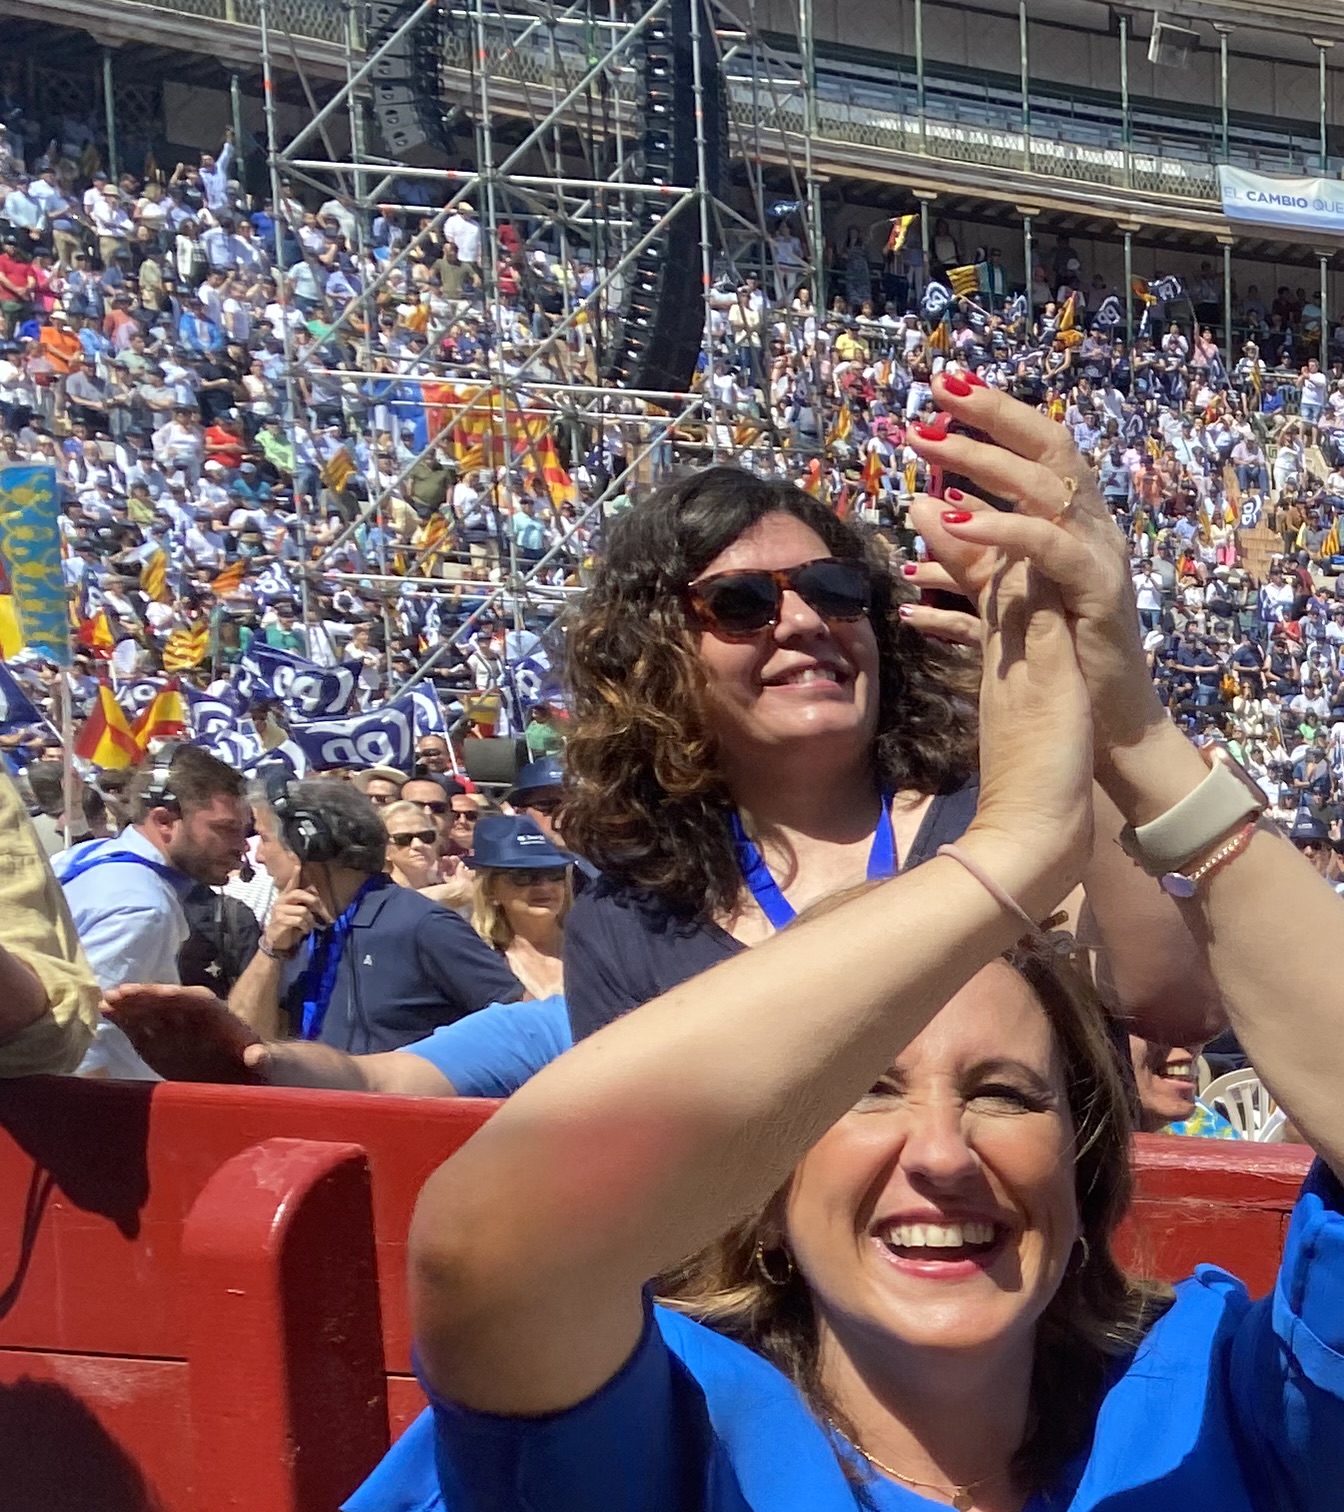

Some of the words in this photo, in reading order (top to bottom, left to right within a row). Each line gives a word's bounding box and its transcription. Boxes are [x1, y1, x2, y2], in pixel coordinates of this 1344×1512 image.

[1223, 186, 1242, 200] EL
[1247, 190, 1308, 209] CAMBIO
[1312, 199, 1344, 214] QUE
